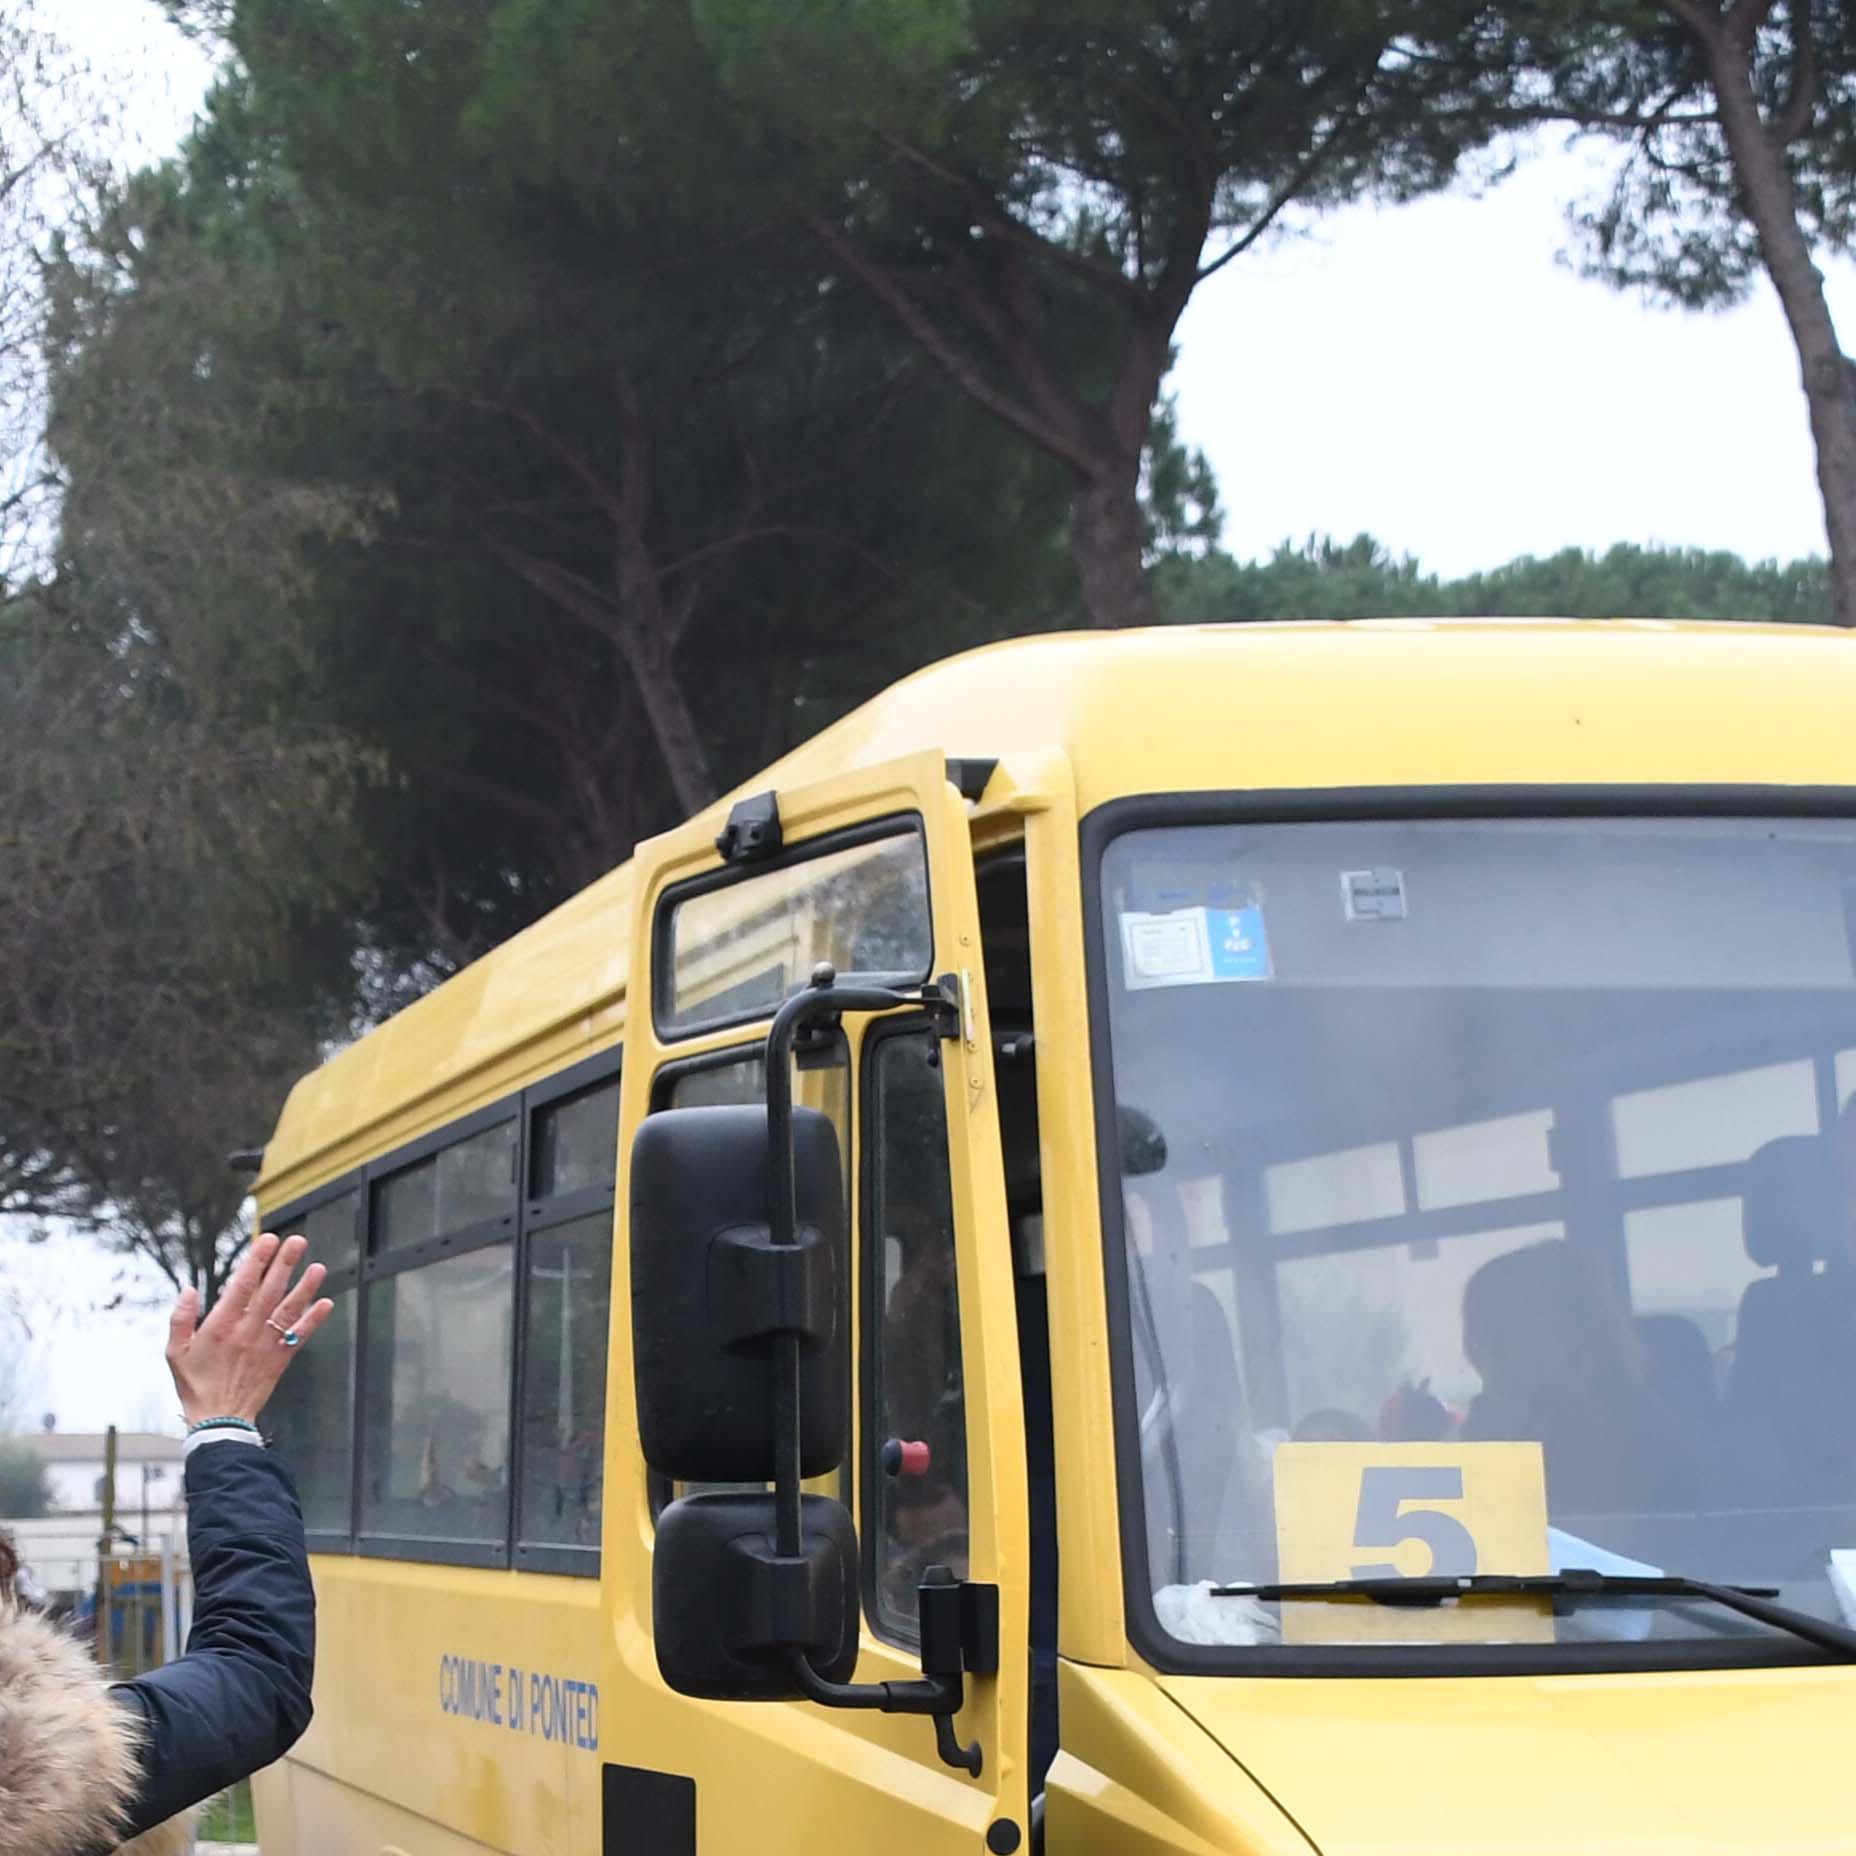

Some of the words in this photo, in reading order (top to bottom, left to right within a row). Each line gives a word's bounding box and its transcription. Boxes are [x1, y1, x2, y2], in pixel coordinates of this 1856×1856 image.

[1349, 1466, 1478, 1580] 5
[440, 1653, 502, 1725] COMUNE
[509, 1667, 524, 1731] DI
